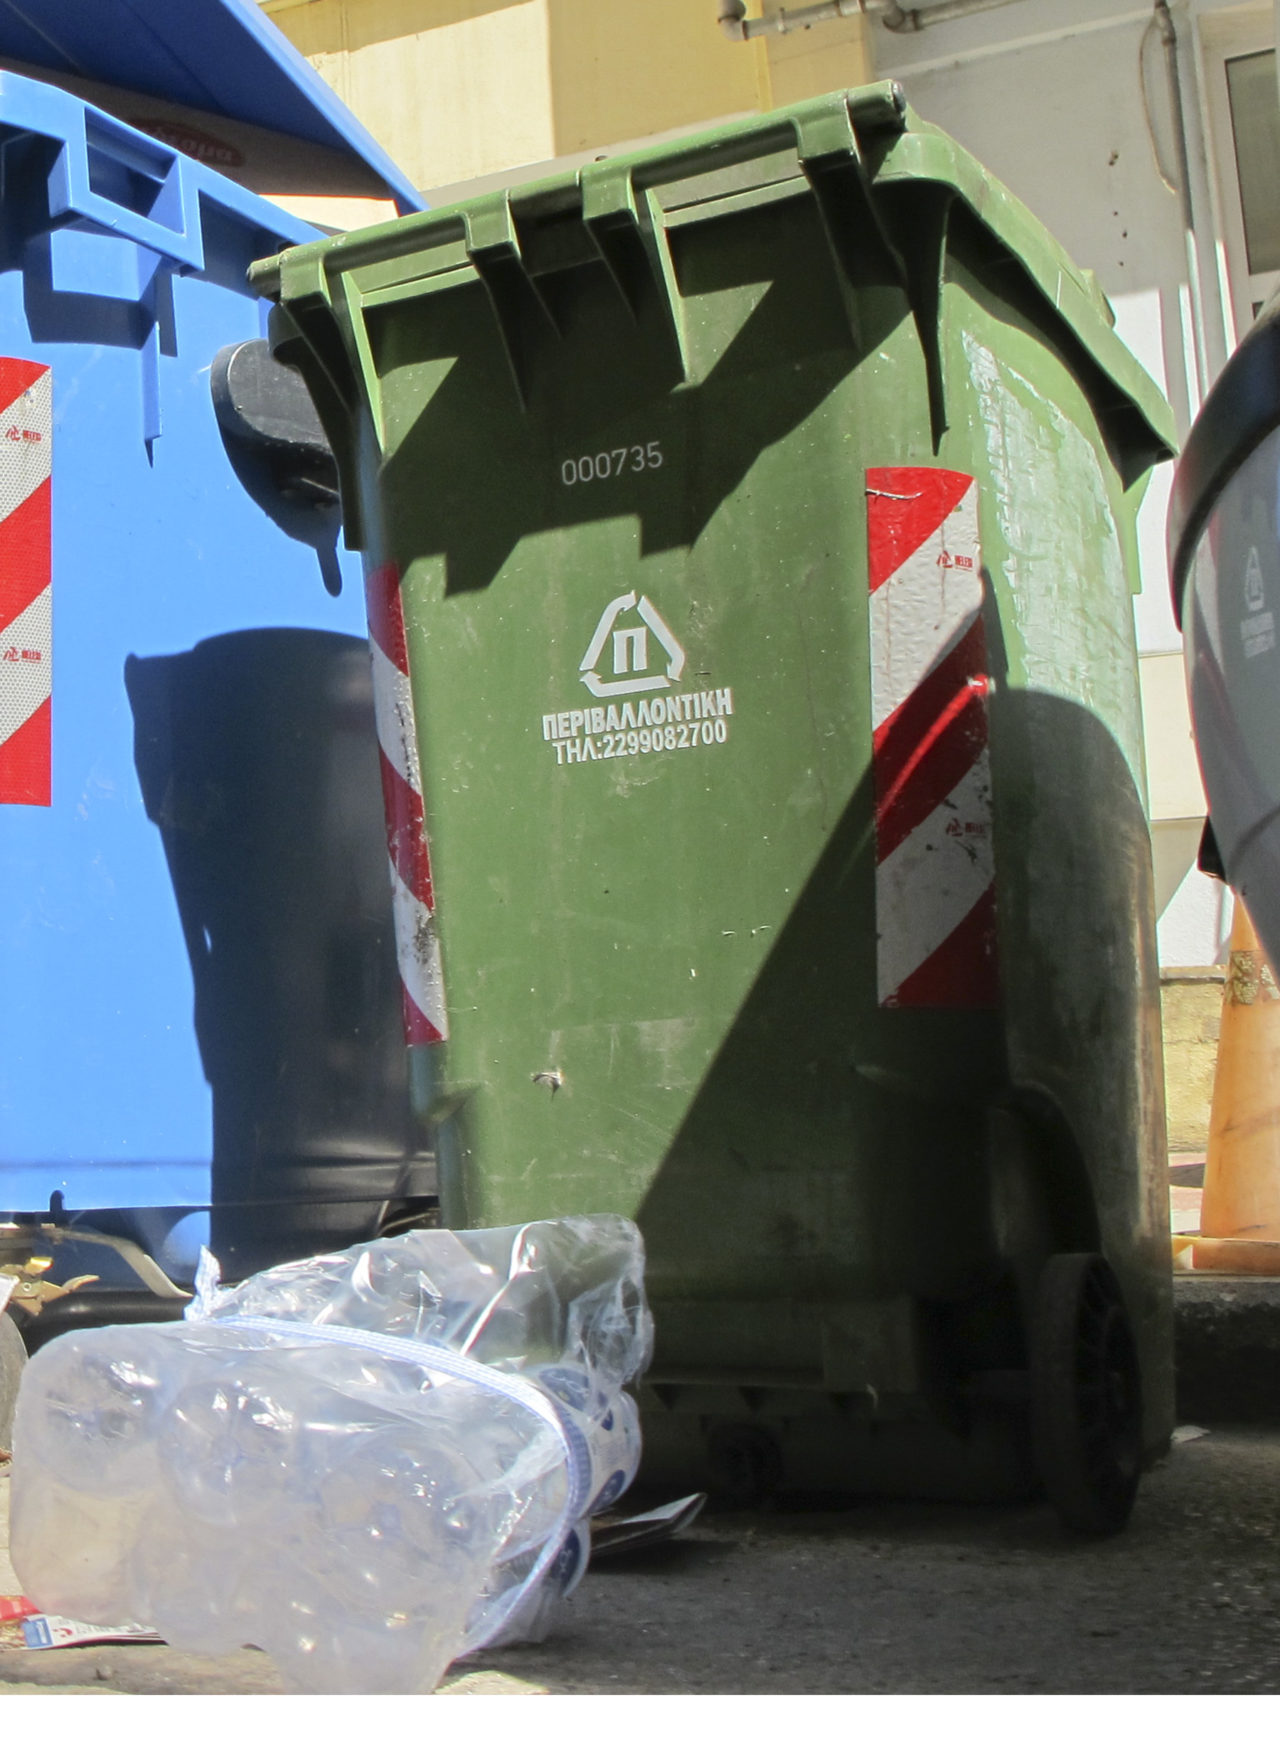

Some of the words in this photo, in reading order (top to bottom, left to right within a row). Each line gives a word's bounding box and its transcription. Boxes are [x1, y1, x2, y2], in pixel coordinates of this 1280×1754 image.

[561, 441, 663, 485] 000735
[542, 687, 734, 741] ΠΕΡΙΒΑΛΛΟΝΤΙΚΗ
[552, 718, 727, 765] ΤΗΛ:2299082700
